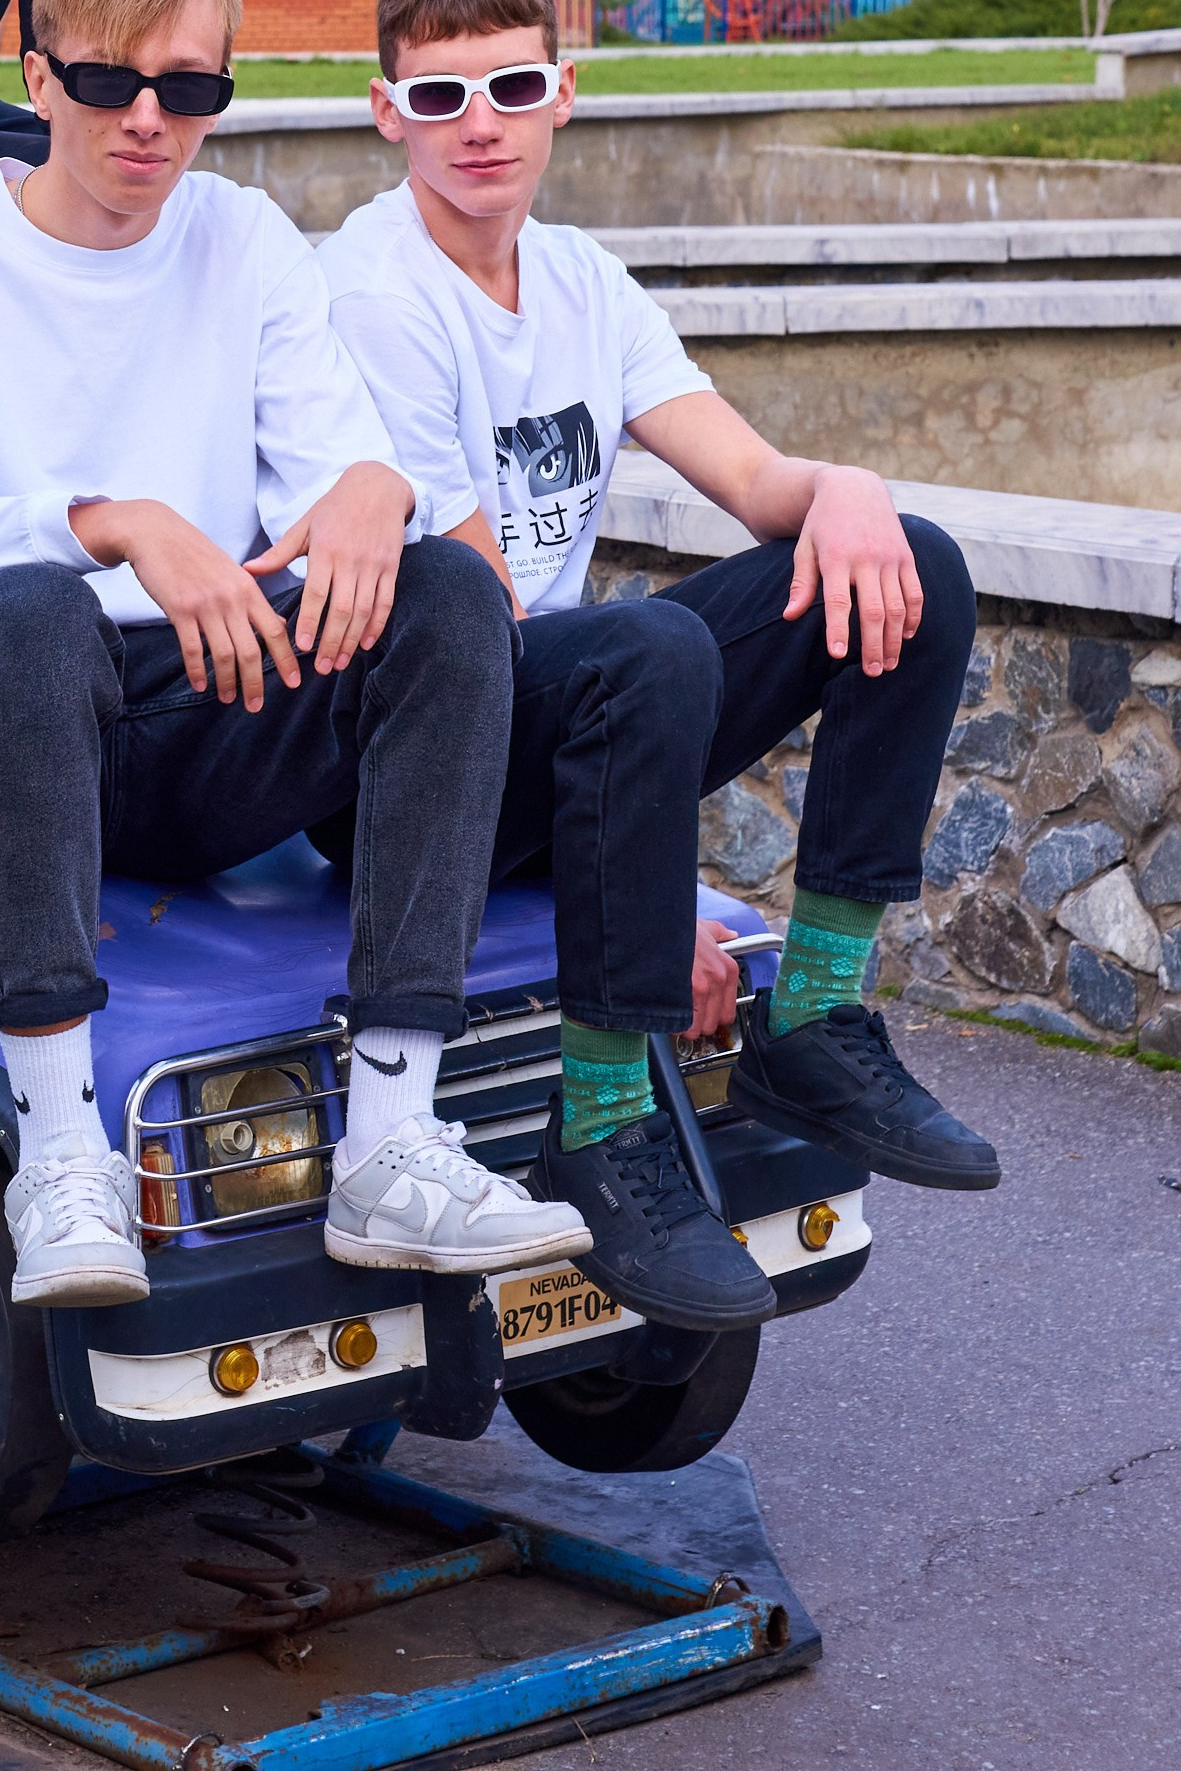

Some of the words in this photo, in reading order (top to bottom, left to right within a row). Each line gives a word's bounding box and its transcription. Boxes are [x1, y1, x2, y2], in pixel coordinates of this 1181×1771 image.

[532, 554, 555, 565] BUILD
[509, 568, 543, 579] РОШЛОЕ.
[543, 564, 564, 575] СТРО
[530, 1272, 592, 1297] NEVADA
